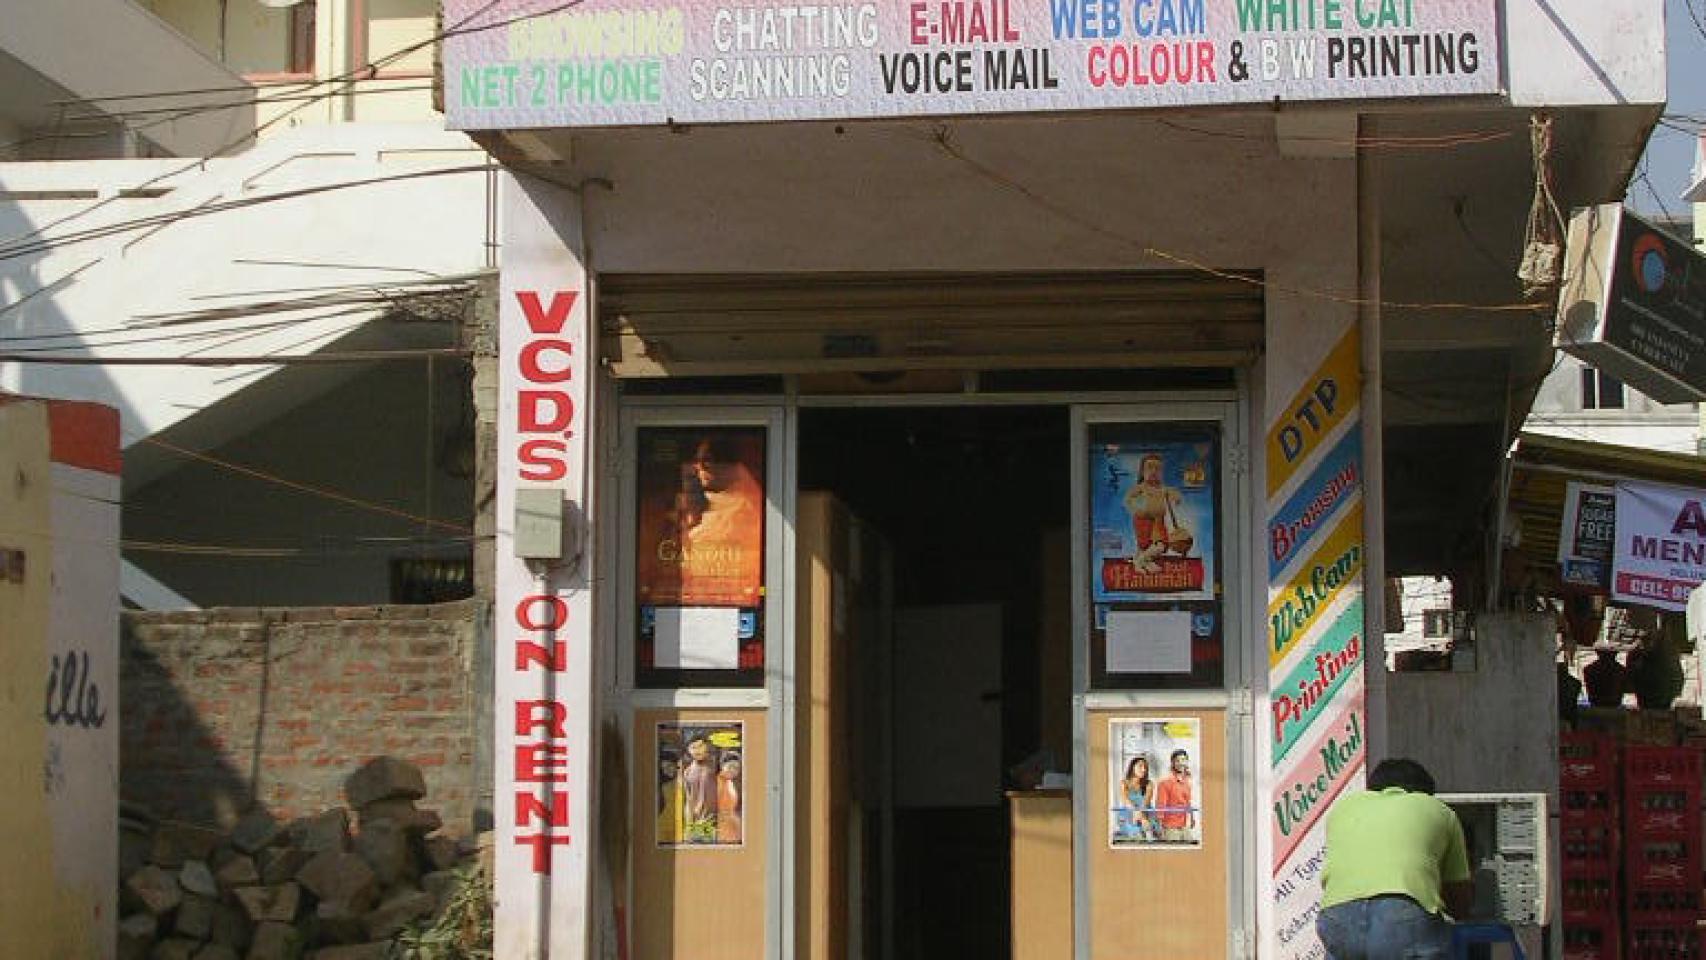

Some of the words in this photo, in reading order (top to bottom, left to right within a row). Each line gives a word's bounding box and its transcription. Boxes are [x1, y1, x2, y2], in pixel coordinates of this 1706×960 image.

[712, 5, 878, 52] CHATTING
[910, 0, 1019, 45] E-MAIL
[1051, 0, 1122, 41] WEB
[1135, 0, 1206, 37] CAM
[1236, 0, 1343, 31] WHITE
[1354, 0, 1416, 29] CAT
[461, 63, 519, 107] NET
[531, 63, 547, 105] 2
[558, 58, 662, 105] PHONE
[690, 55, 850, 100] SCANNING
[879, 51, 973, 94] VOICE
[984, 48, 1058, 91] MAIL
[1088, 41, 1217, 87] COLOUR
[1228, 40, 1249, 82] &
[1262, 39, 1278, 80] B
[1290, 38, 1316, 78] W
[1328, 32, 1480, 80] PRINTING
[1280, 378, 1337, 462] DTP
[514, 594, 569, 672] ON
[1273, 636, 1361, 742] Printing
[513, 700, 570, 876] RENT
